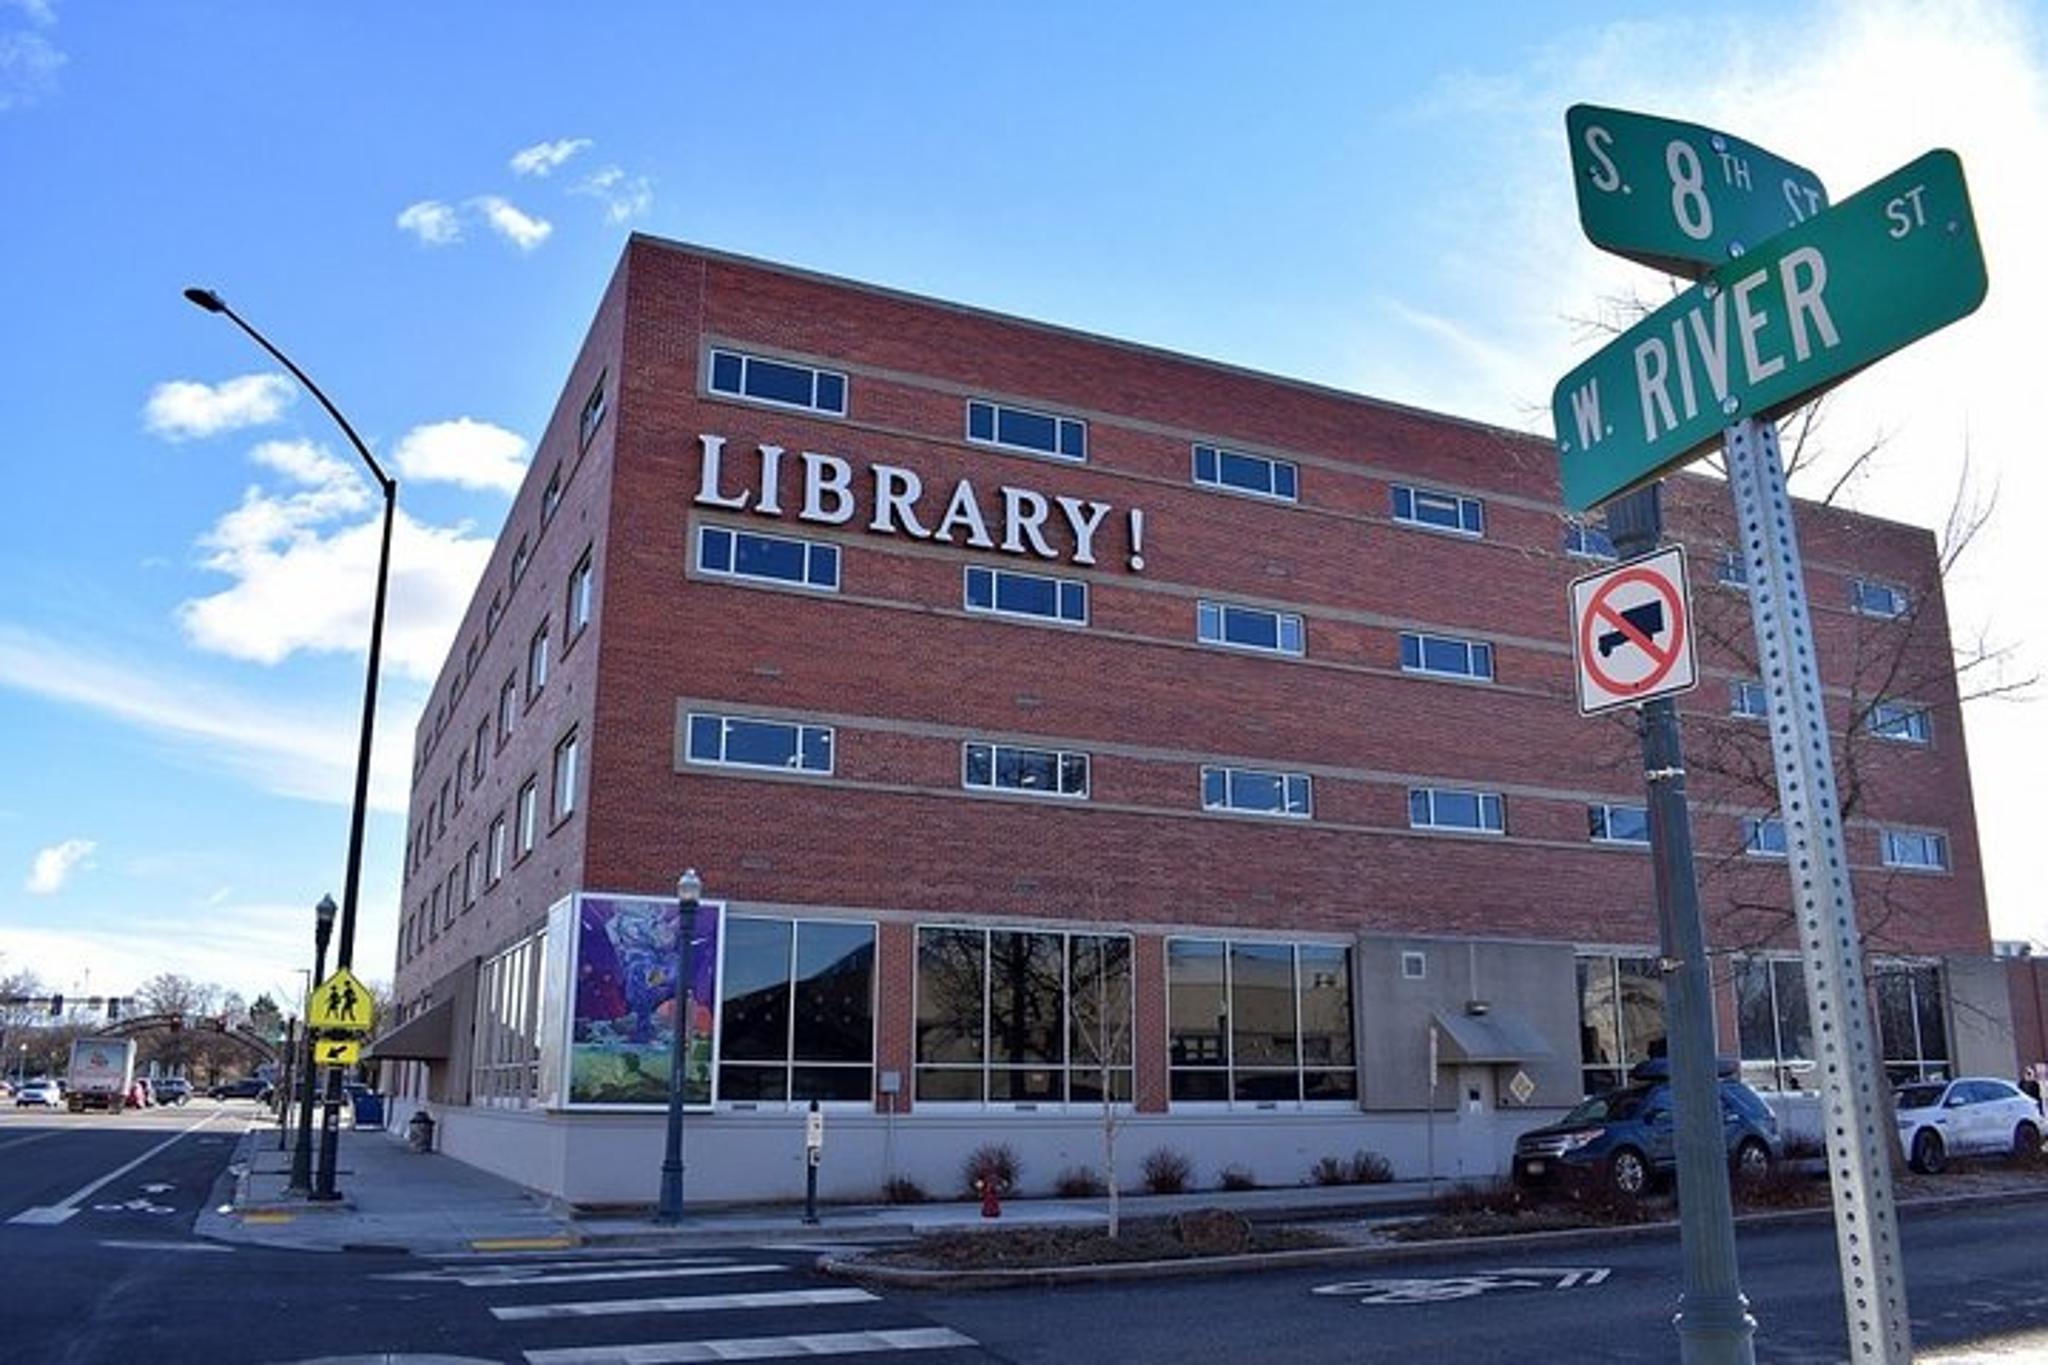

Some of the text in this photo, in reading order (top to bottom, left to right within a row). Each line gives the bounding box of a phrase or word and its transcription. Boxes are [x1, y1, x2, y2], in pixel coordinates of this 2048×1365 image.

[1585, 126, 1632, 194] S.
[1782, 178, 1819, 229] ST
[1571, 184, 1929, 451] W. RIVER ST
